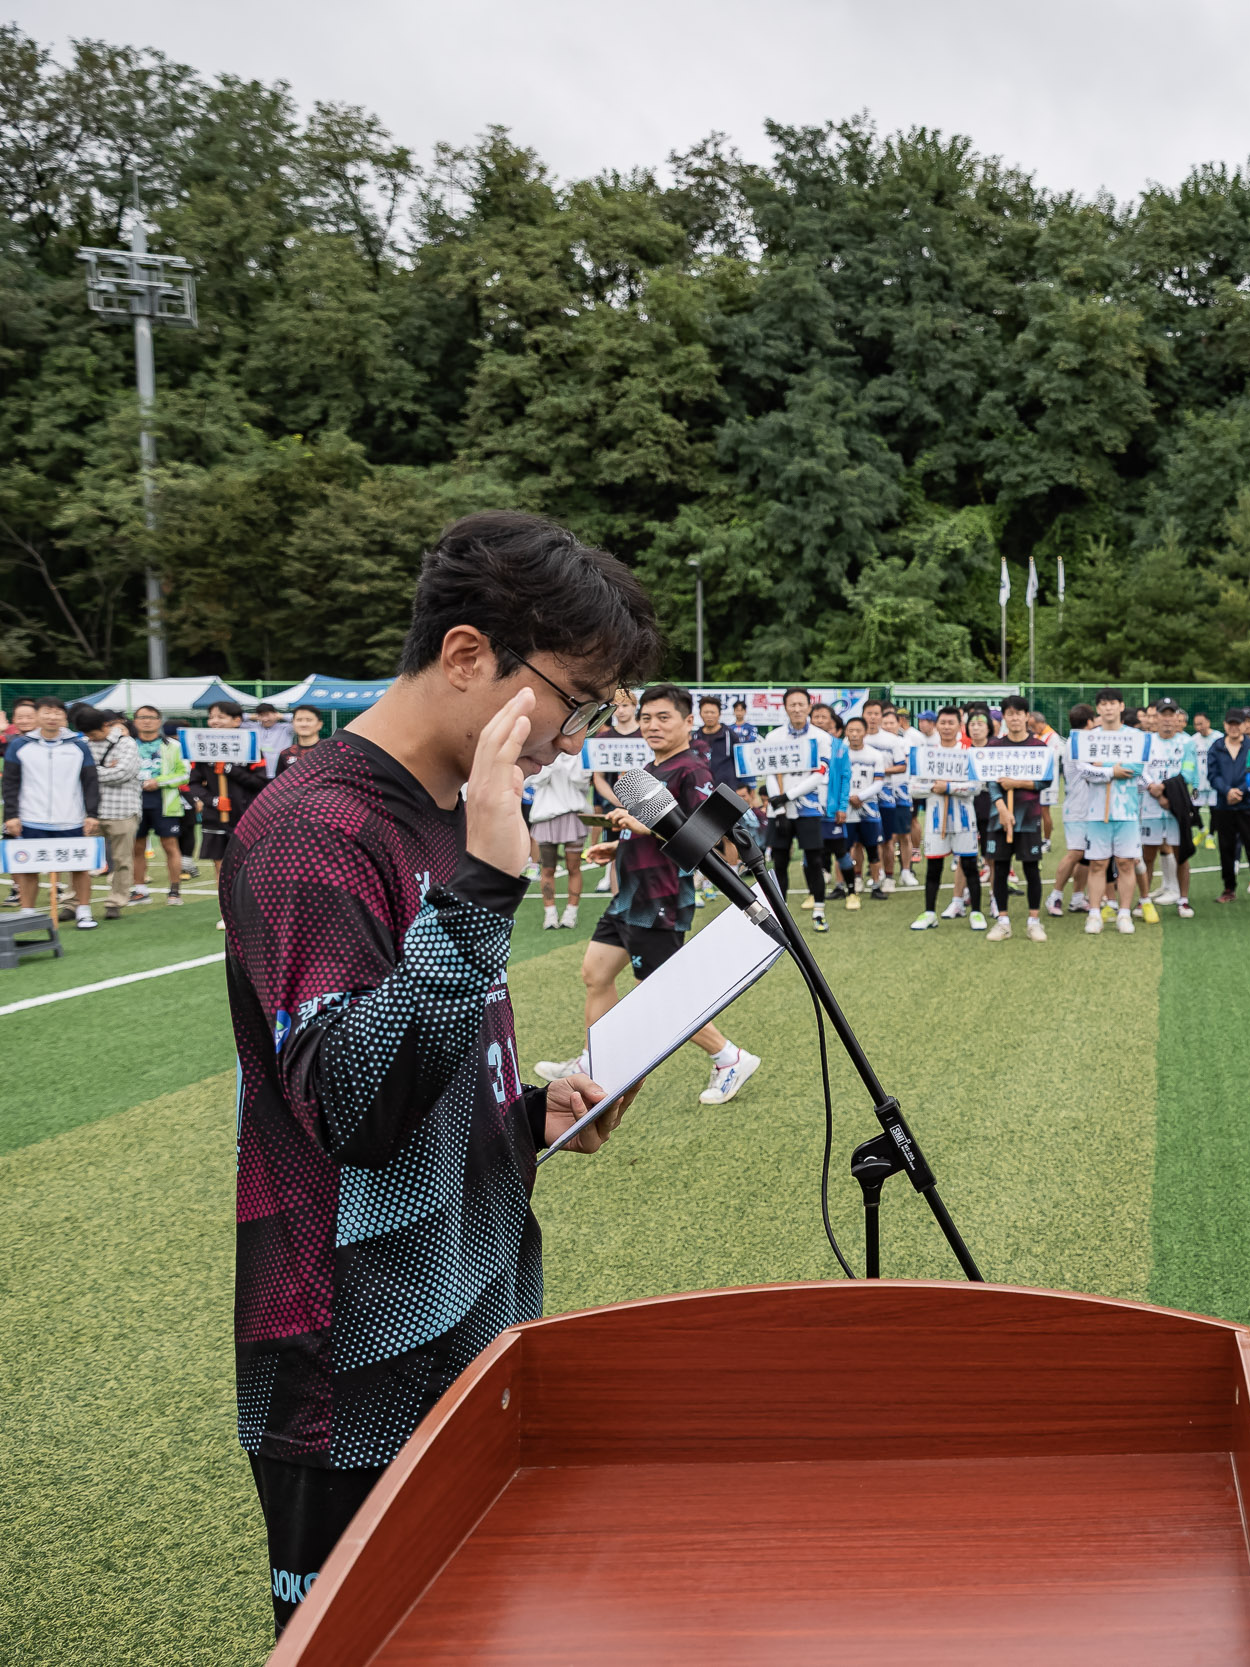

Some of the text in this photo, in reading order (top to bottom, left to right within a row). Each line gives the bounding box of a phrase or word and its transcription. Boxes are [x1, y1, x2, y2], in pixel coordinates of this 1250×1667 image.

[1089, 743, 1133, 757] 율리족구
[599, 752, 646, 767] 그린족구
[756, 753, 800, 771] 상록족구
[36, 848, 88, 862] 초청부
[892, 1127, 905, 1143] SMI
